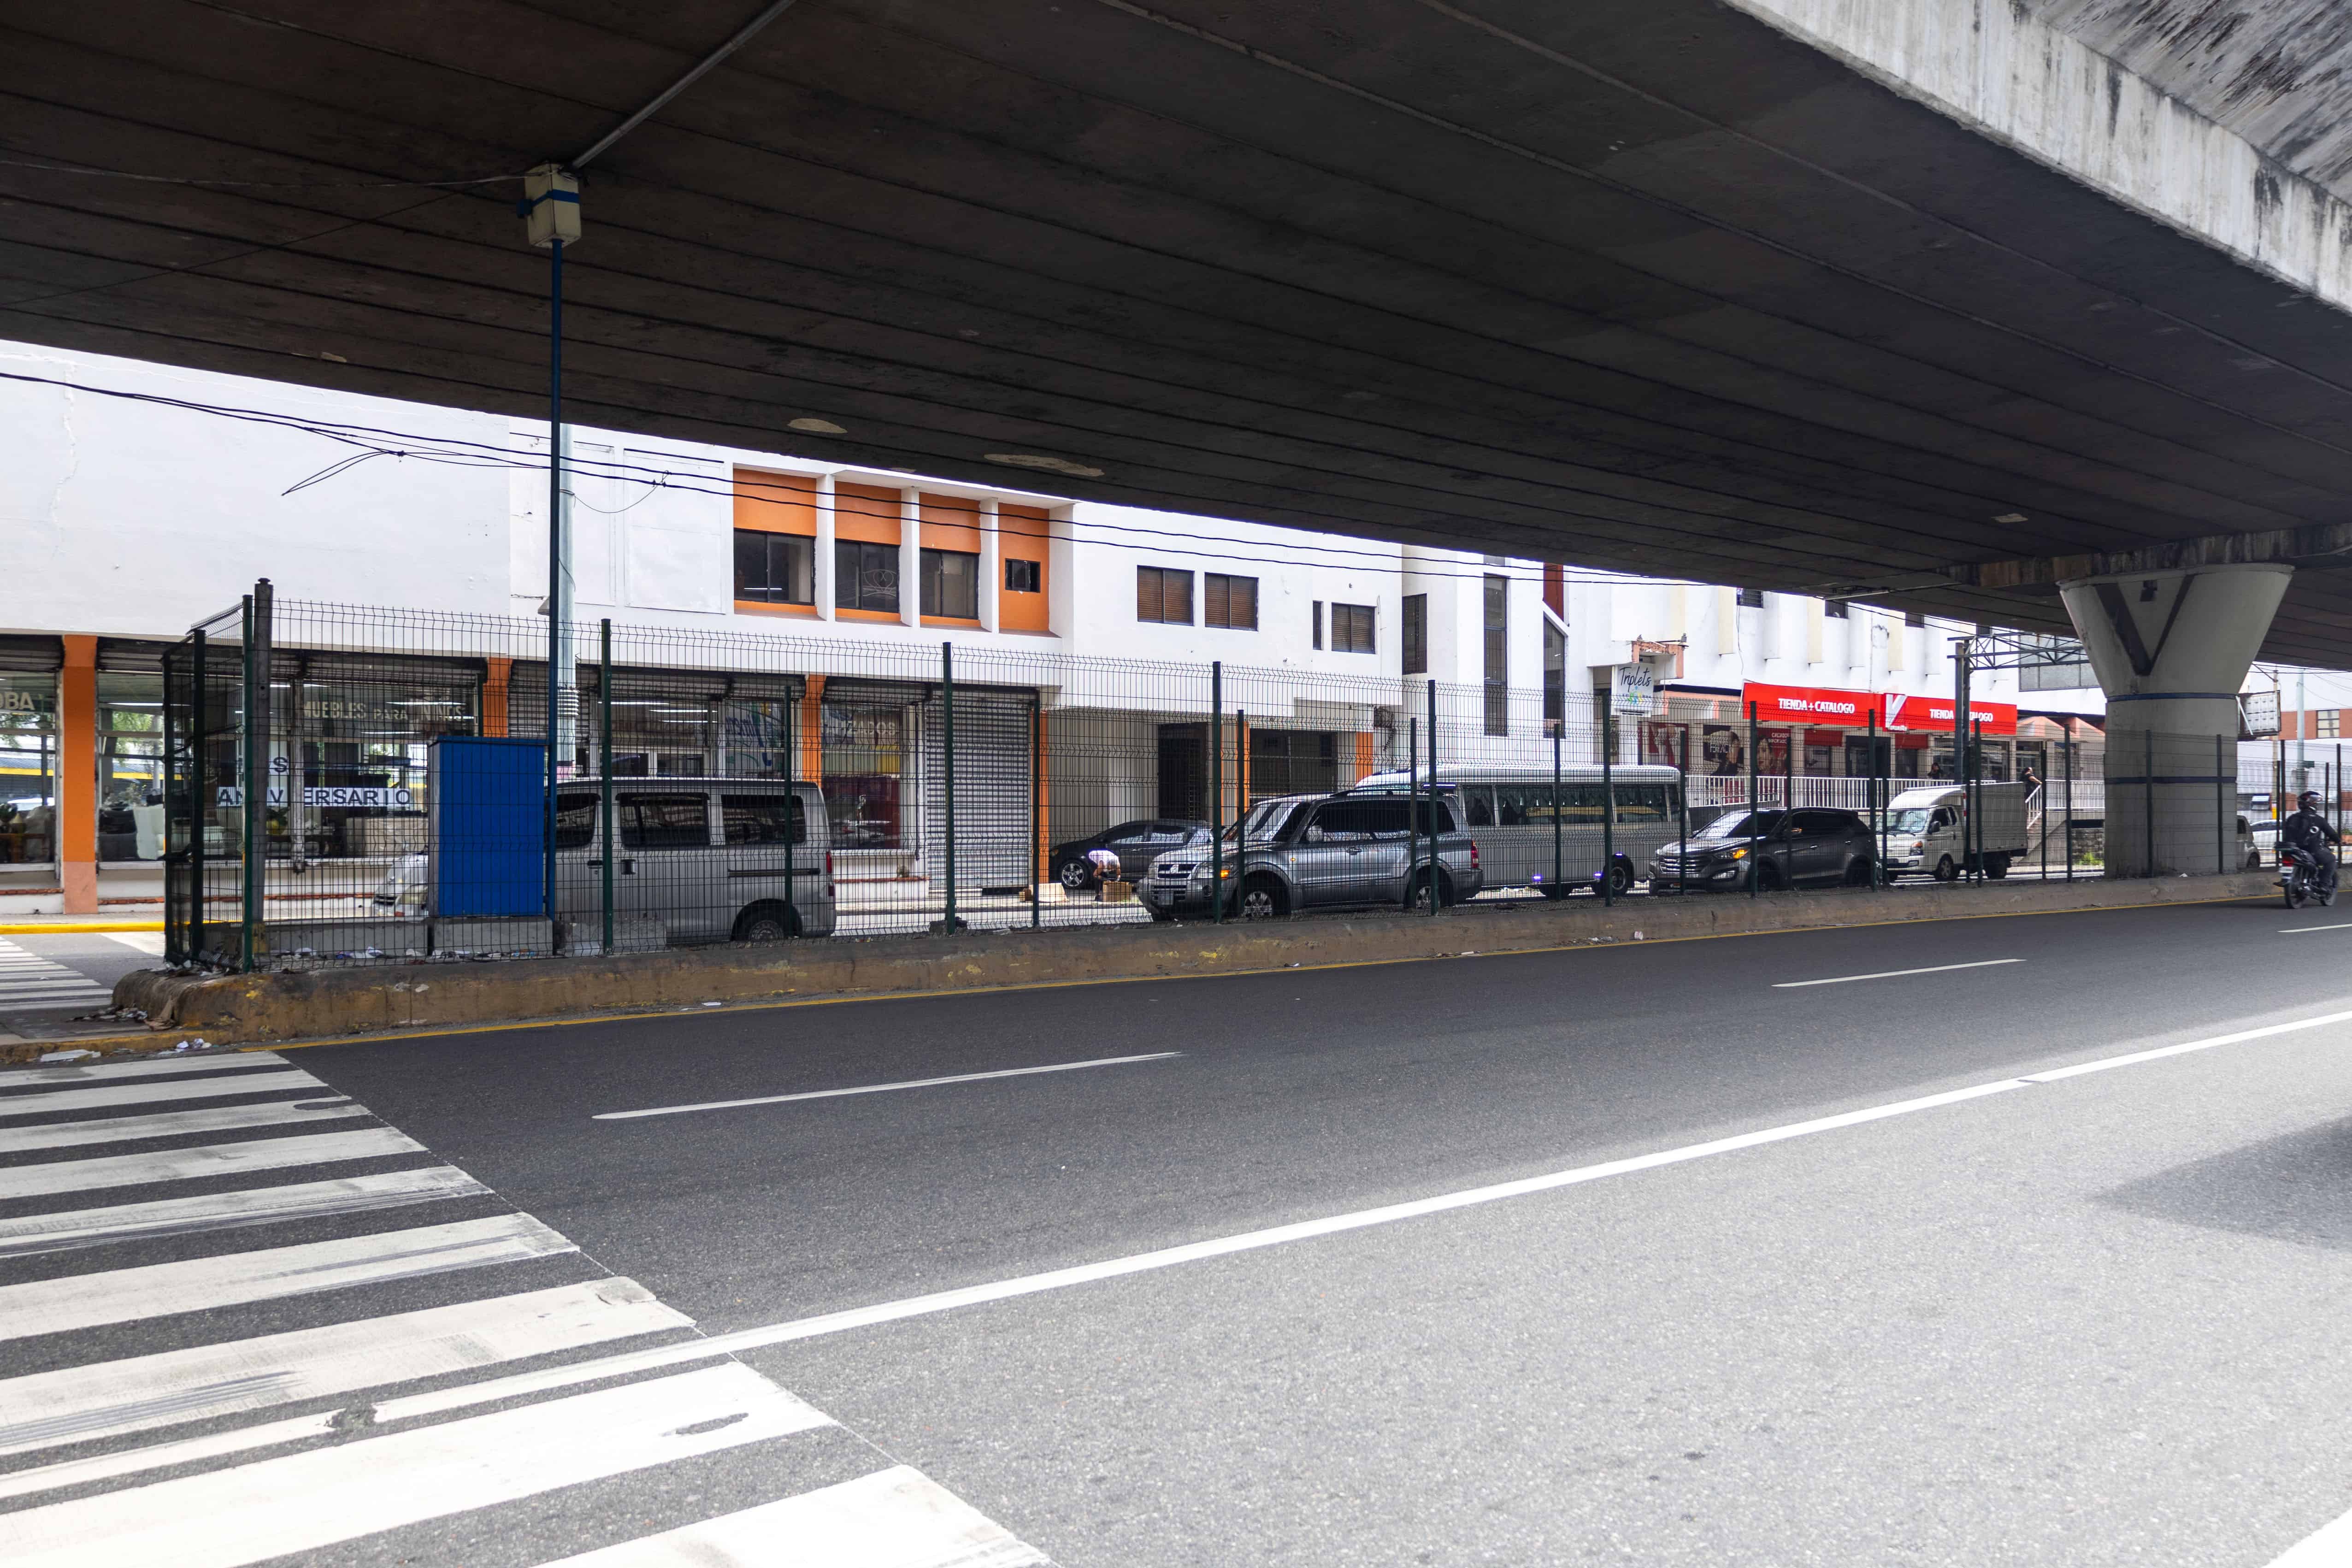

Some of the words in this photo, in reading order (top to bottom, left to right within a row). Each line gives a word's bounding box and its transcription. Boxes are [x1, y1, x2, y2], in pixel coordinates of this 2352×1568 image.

[1619, 666, 1652, 693] Triplets
[303, 701, 366, 719] MUEBLES
[373, 708, 408, 720] PARA
[1778, 698, 1808, 711] TIENDA
[1815, 701, 1855, 714] CATALOGO
[1929, 708, 1954, 720] TIENDA
